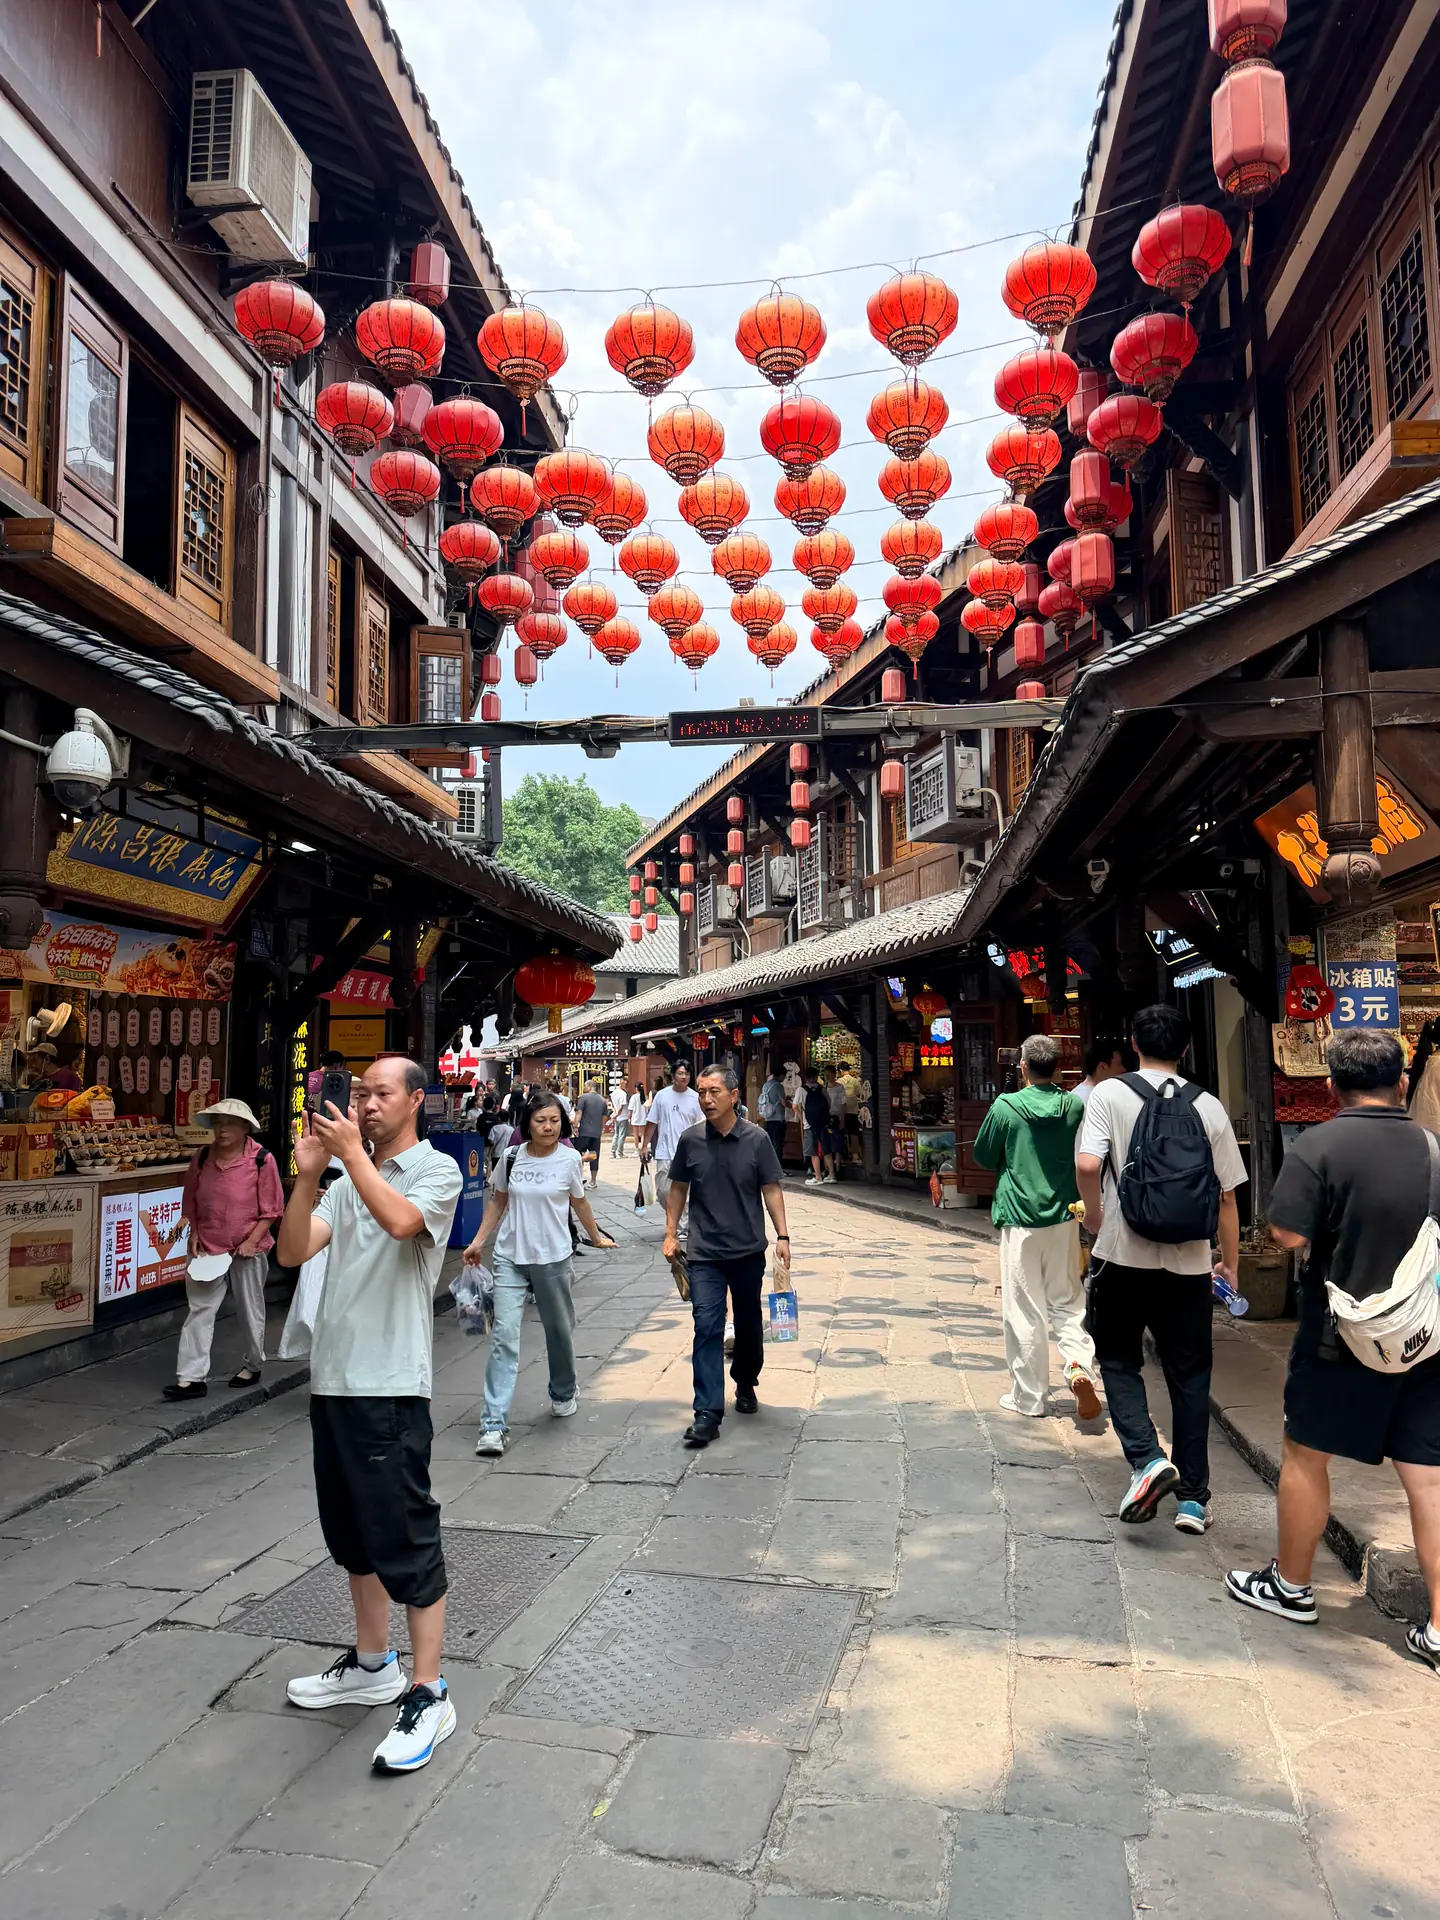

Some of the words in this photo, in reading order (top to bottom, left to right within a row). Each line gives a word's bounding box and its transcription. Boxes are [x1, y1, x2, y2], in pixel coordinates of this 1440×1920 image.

[60, 925, 117, 951] 今日麻花节
[47, 947, 110, 972] 今天不卷放松一下
[1329, 967, 1395, 989] 冰箱贴
[1339, 996, 1389, 1022] 3元
[570, 1040, 615, 1051] 小猪找茶
[5, 1199, 76, 1216] 陈昌银麻花
[149, 1202, 181, 1226] 送特产
[114, 1219, 132, 1293] 重庆
[140, 1271, 157, 1286] 小红书
[1404, 1325, 1428, 1355] NIKE
